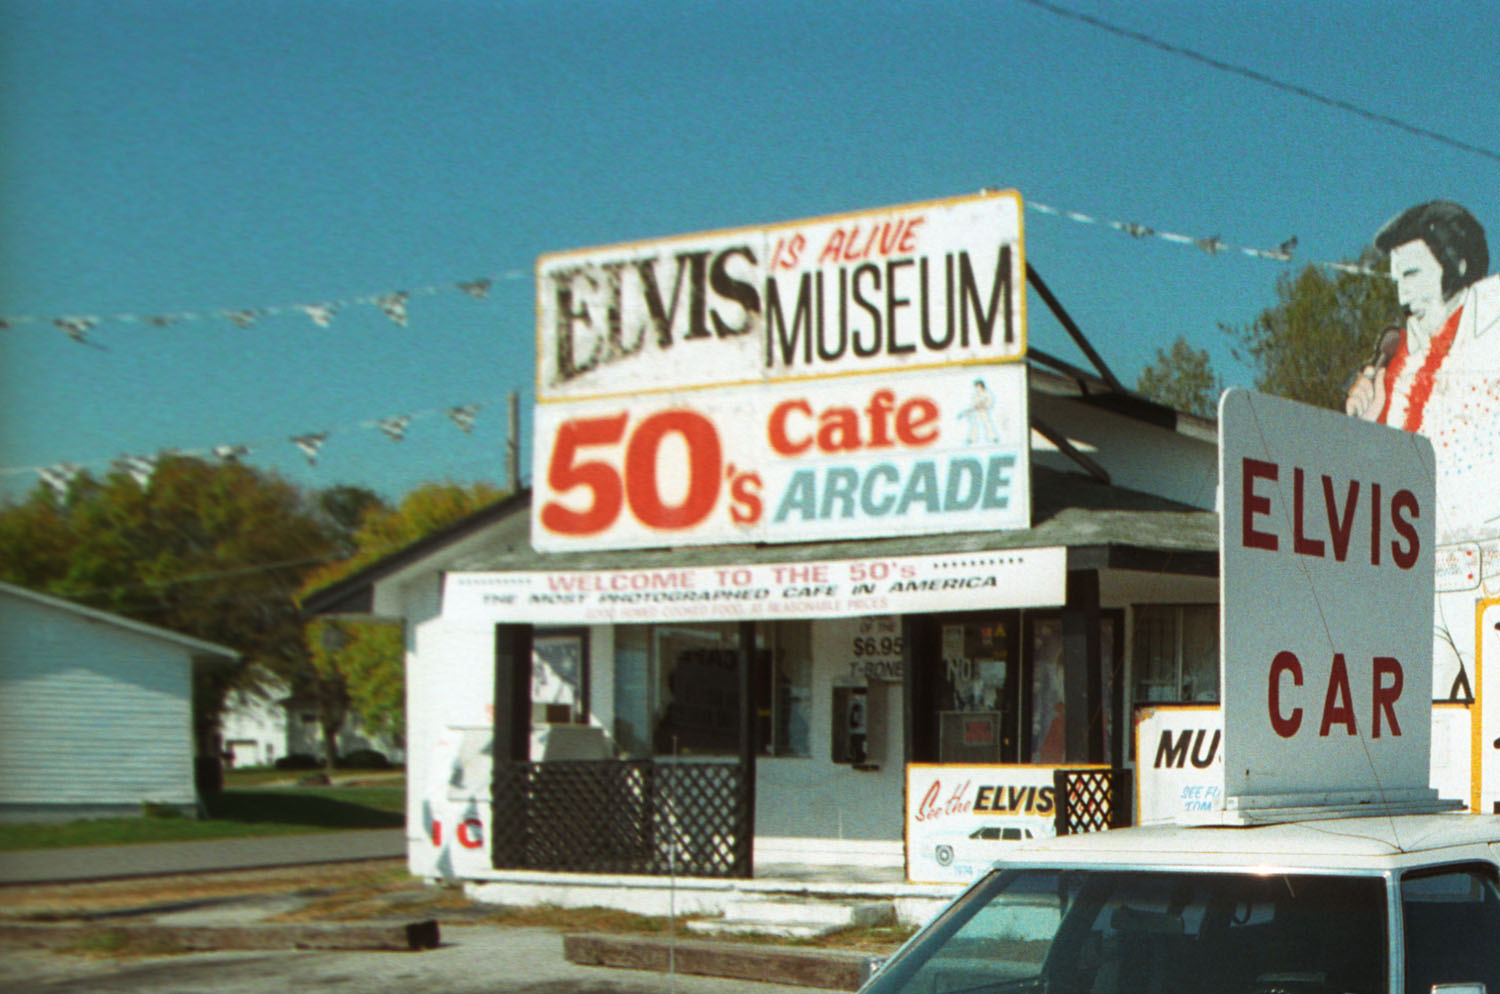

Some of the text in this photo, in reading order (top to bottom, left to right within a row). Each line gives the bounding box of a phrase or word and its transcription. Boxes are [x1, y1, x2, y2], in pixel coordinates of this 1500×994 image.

[769, 216, 925, 272] IS ALIVE
[547, 244, 1014, 387] ELVIS MUSEUM
[767, 389, 940, 457] Cafe
[540, 408, 764, 536] 50's
[771, 453, 1016, 523] ARCADE
[1242, 457, 1421, 570] ELVIS
[547, 569, 696, 592] WELCOME
[716, 567, 753, 588] TO
[771, 565, 829, 585] THE
[851, 581, 876, 595] IN
[889, 576, 998, 593] AMERICA
[1267, 650, 1405, 740] CAR
[1153, 729, 1222, 770] MU
[972, 784, 1056, 816] ELVIS
